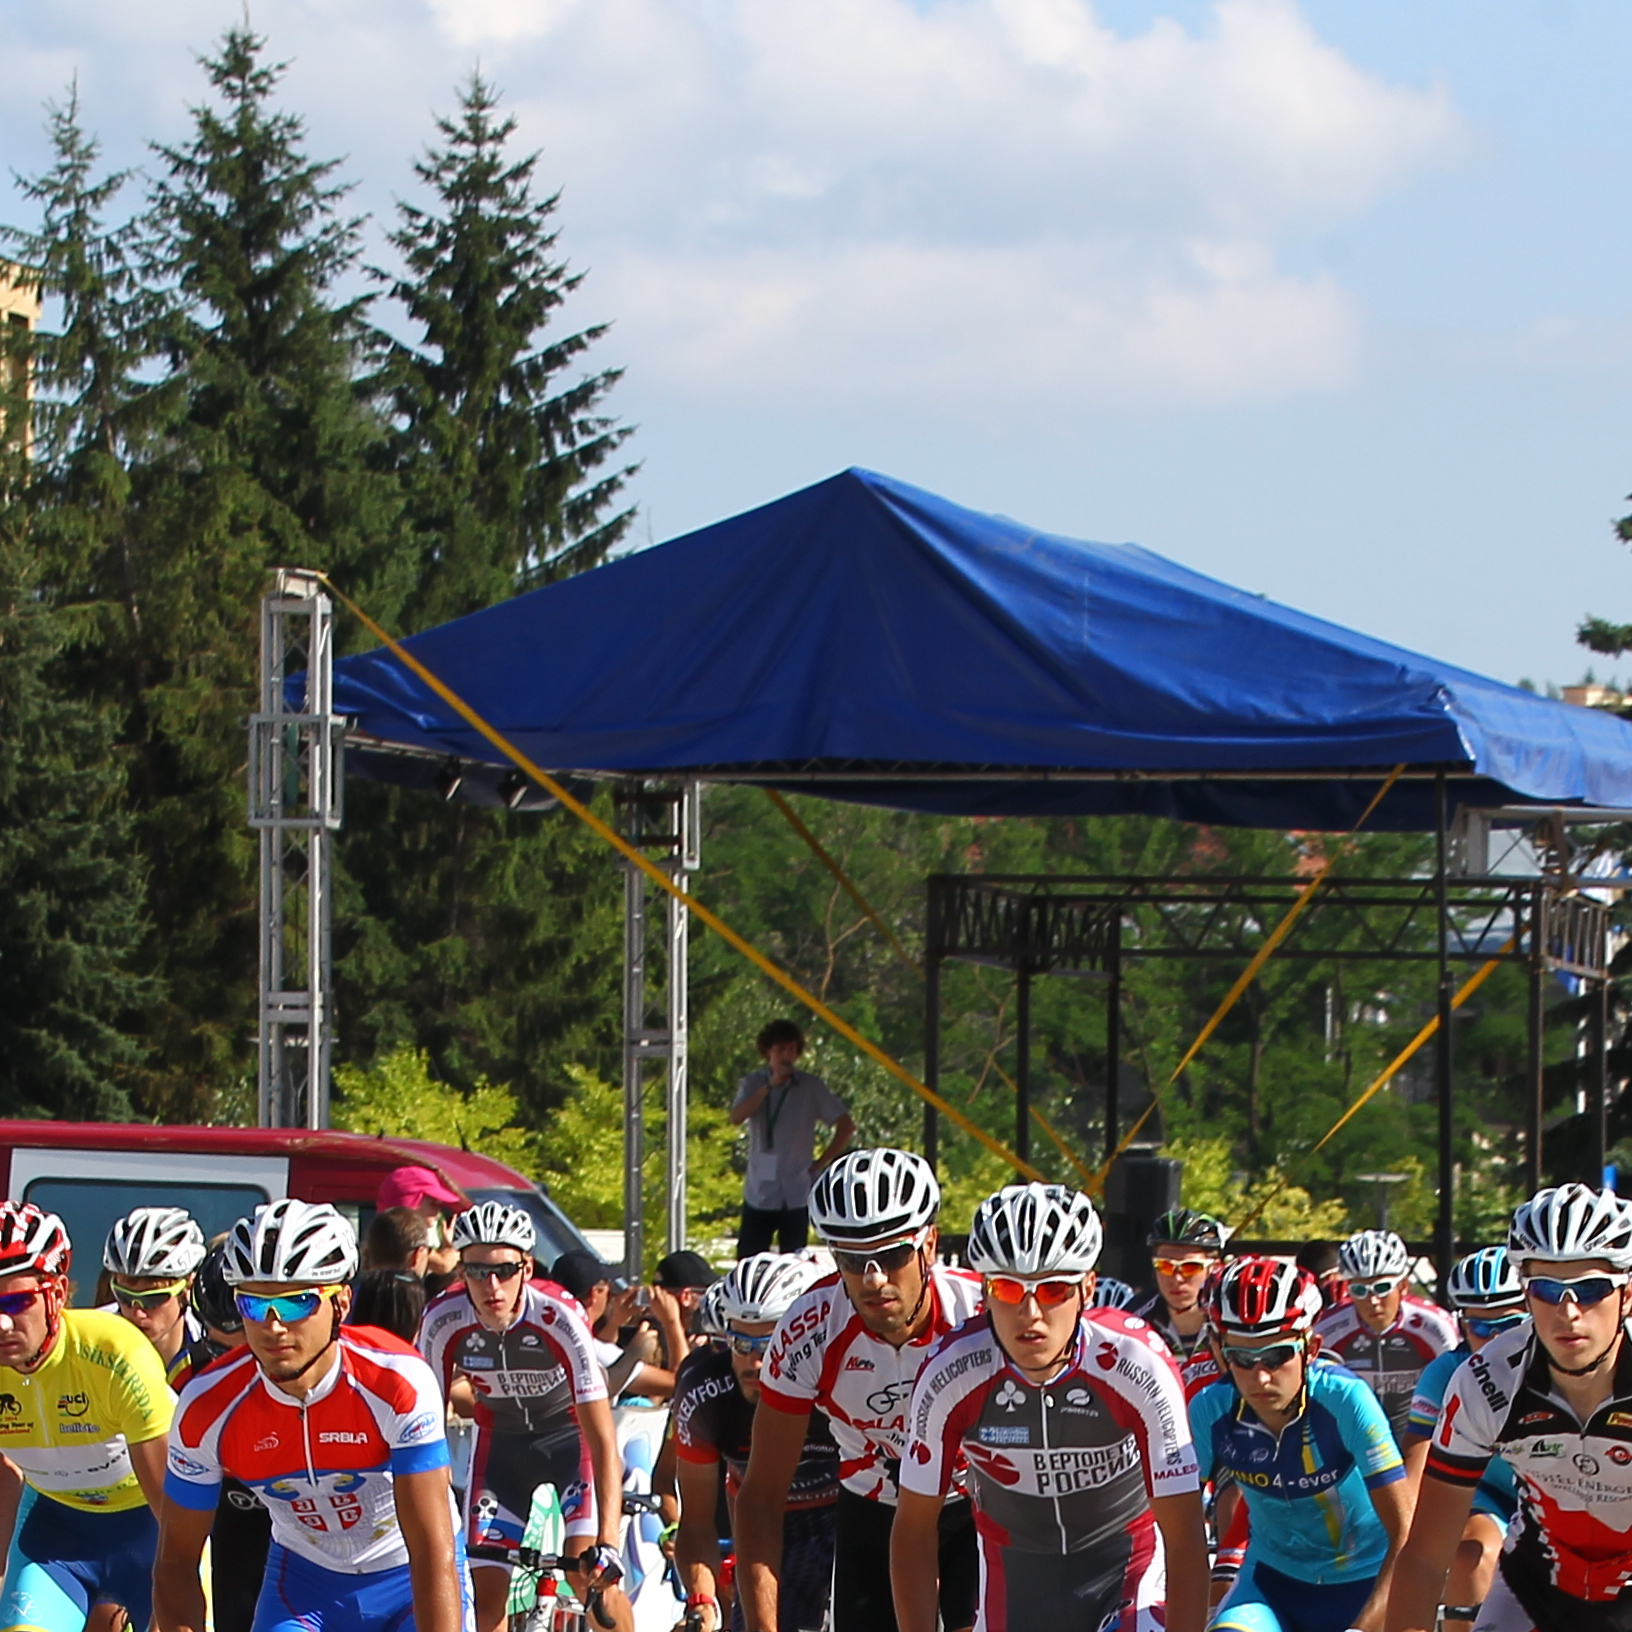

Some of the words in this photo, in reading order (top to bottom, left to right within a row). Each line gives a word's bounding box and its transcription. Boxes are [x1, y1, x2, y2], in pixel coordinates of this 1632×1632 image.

[929, 1349, 993, 1393] HELICOPTERS
[1468, 1353, 1509, 1414] cinelli
[1116, 1358, 1160, 1400] RUSSIAN
[1155, 1396, 1184, 1466] HELICOPTERS
